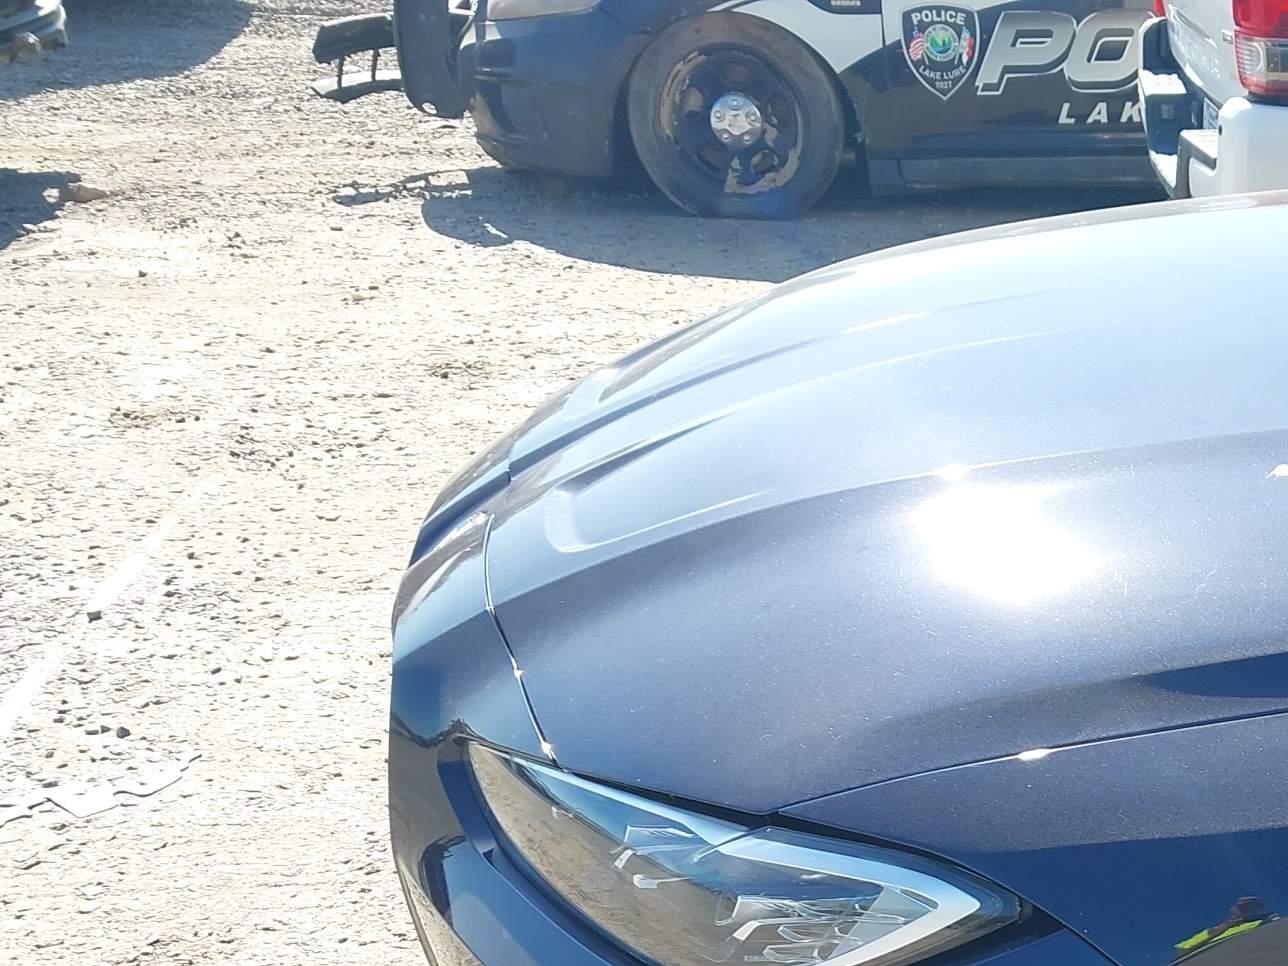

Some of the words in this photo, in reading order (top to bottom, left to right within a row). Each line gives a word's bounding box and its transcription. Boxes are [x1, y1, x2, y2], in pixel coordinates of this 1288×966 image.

[911, 9, 967, 25] POLICE
[975, 10, 1156, 95] PO
[919, 65, 942, 80] LAKE
[943, 65, 967, 80] LURE
[1058, 101, 1143, 124] LAK
